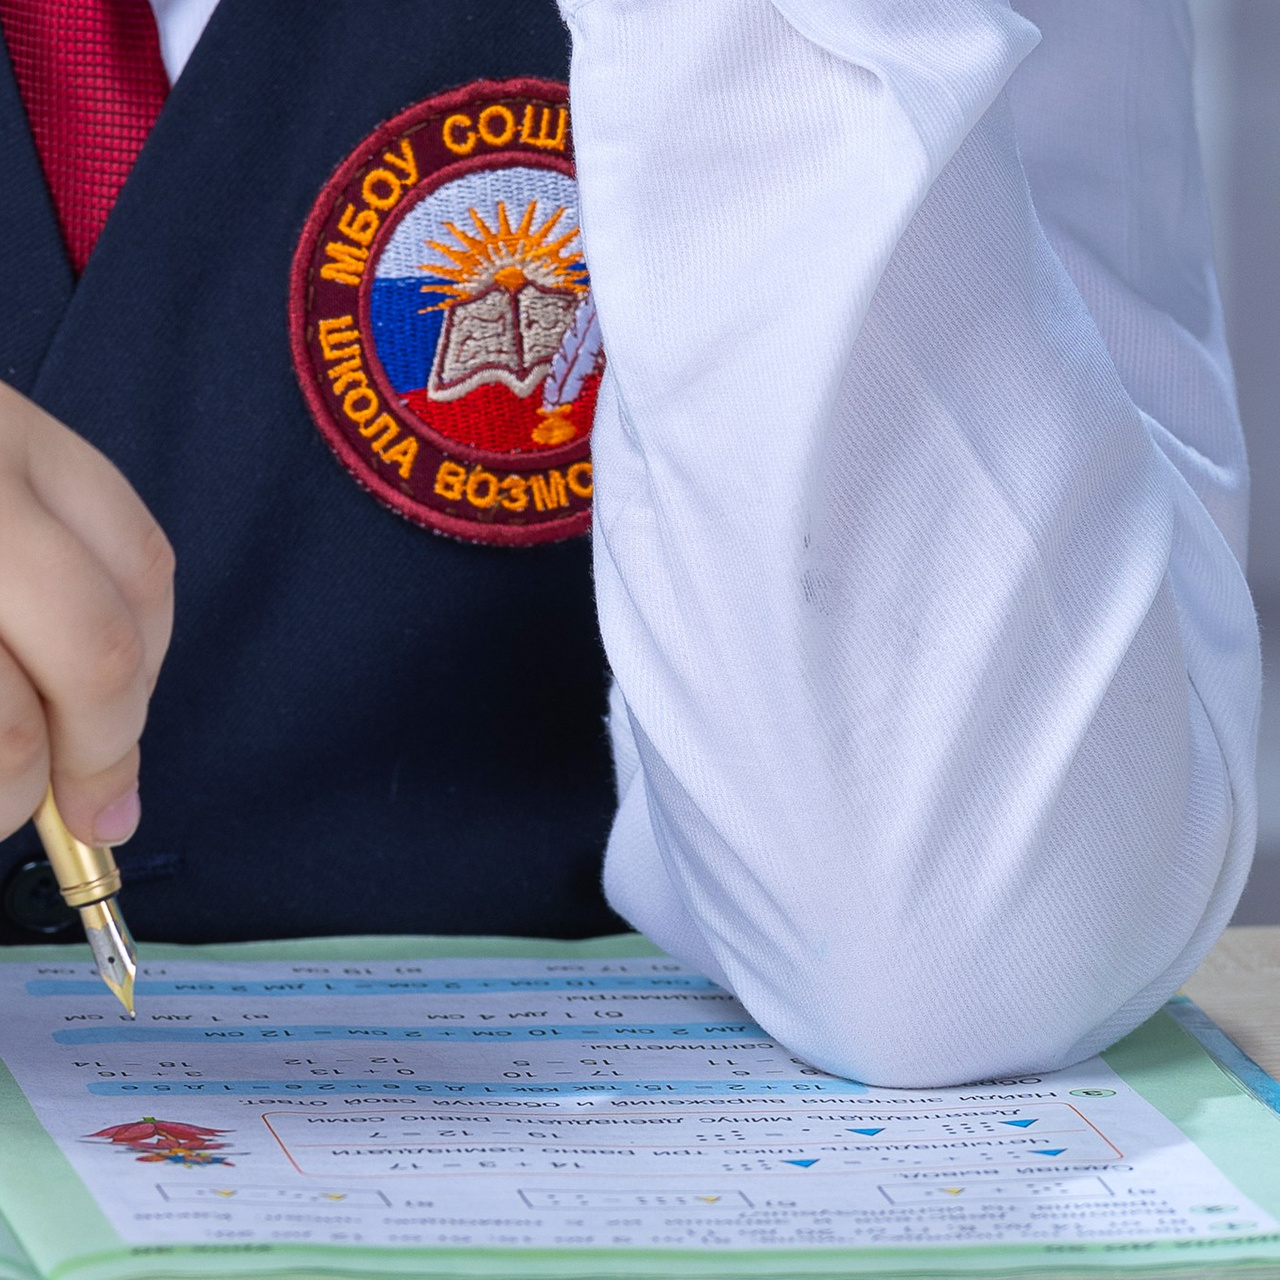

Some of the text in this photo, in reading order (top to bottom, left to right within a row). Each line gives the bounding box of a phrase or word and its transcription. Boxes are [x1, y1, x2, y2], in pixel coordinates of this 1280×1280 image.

[320, 103, 568, 286] МБОУ СОШ
[319, 315, 421, 479] ШКОЛА
[807, 1110, 1022, 1122] Девятнадцать
[821, 1139, 1051, 1152] Четырнадцать
